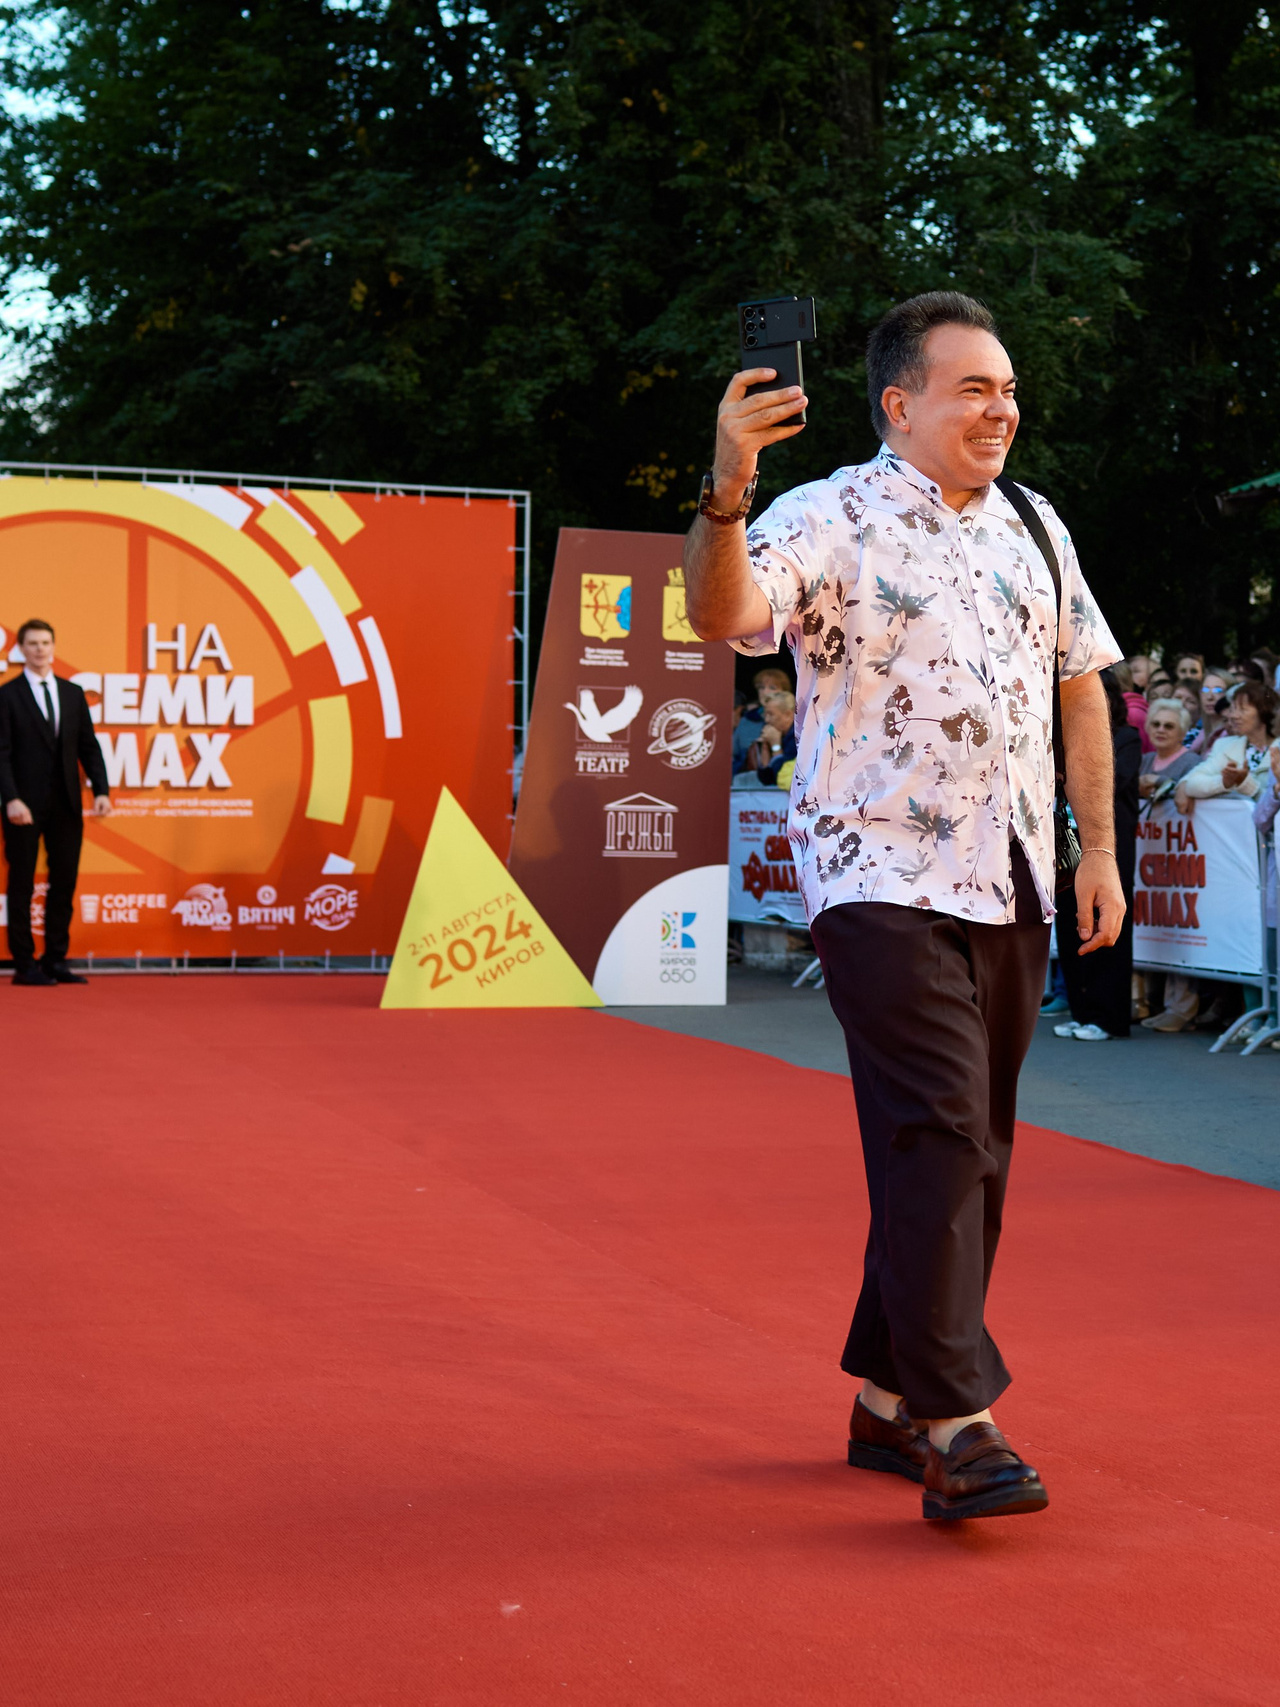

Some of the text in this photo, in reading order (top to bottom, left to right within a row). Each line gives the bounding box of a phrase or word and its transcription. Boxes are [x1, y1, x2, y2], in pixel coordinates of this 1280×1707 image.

[147, 623, 233, 671] НА
[69, 672, 254, 726] СЕМИ
[95, 733, 232, 788] МАХ
[575, 757, 630, 774] ТЕАТР
[670, 739, 712, 767] КОСМОС
[605, 811, 673, 850] ДРУЖБА
[1165, 820, 1198, 852] НА
[1140, 853, 1206, 888] СЕМИ
[102, 894, 167, 909] COFFEE
[102, 909, 139, 923] LIKE
[238, 906, 295, 925] ВЯТИЧ
[304, 890, 358, 920] МОРЕ
[441, 892, 518, 938] АВГУСТА
[1133, 890, 1200, 929] ЛМАХ
[418, 909, 532, 990] 2024
[476, 941, 545, 988] КИРОВ
[660, 958, 696, 966] КИРОВ
[659, 969, 696, 984] 650
